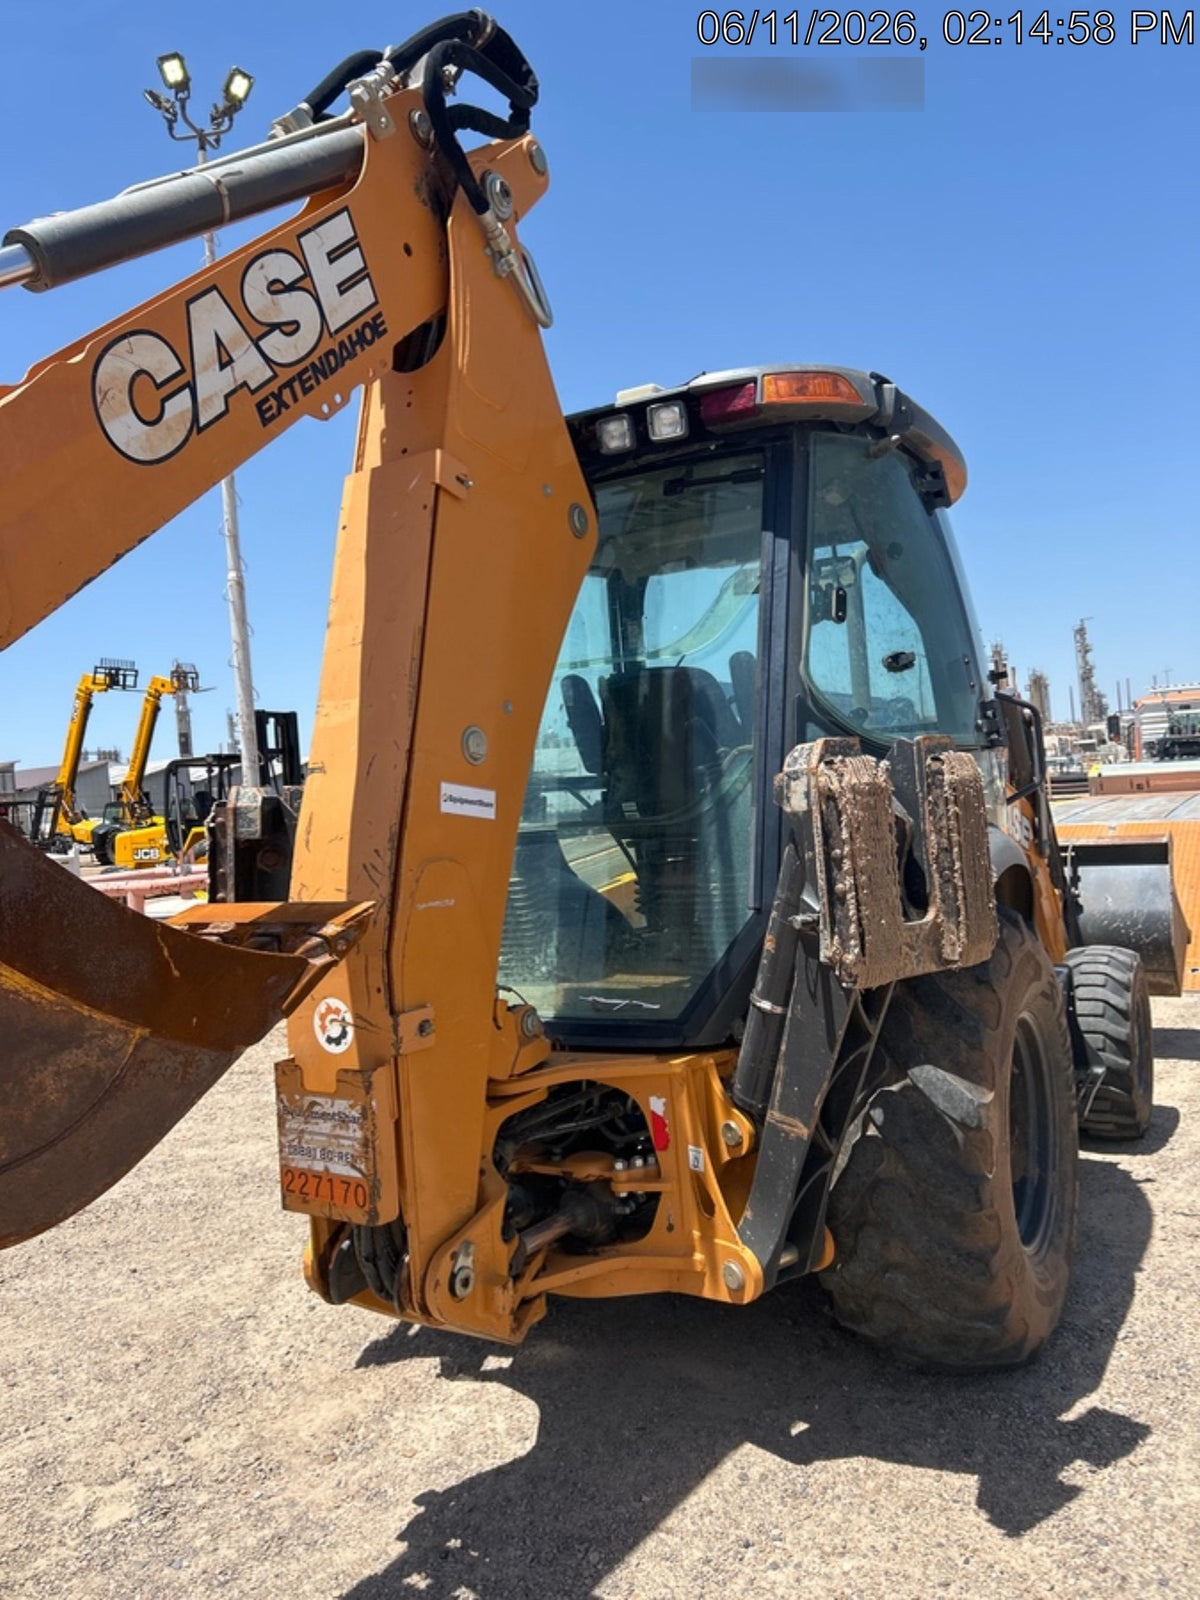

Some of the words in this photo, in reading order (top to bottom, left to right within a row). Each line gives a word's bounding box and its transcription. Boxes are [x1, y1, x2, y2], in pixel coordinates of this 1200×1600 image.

[91, 206, 379, 466] CASE
[256, 312, 389, 428] EXTENDAHOE
[134, 848, 160, 860] JCB
[284, 1170, 368, 1209] 227170
